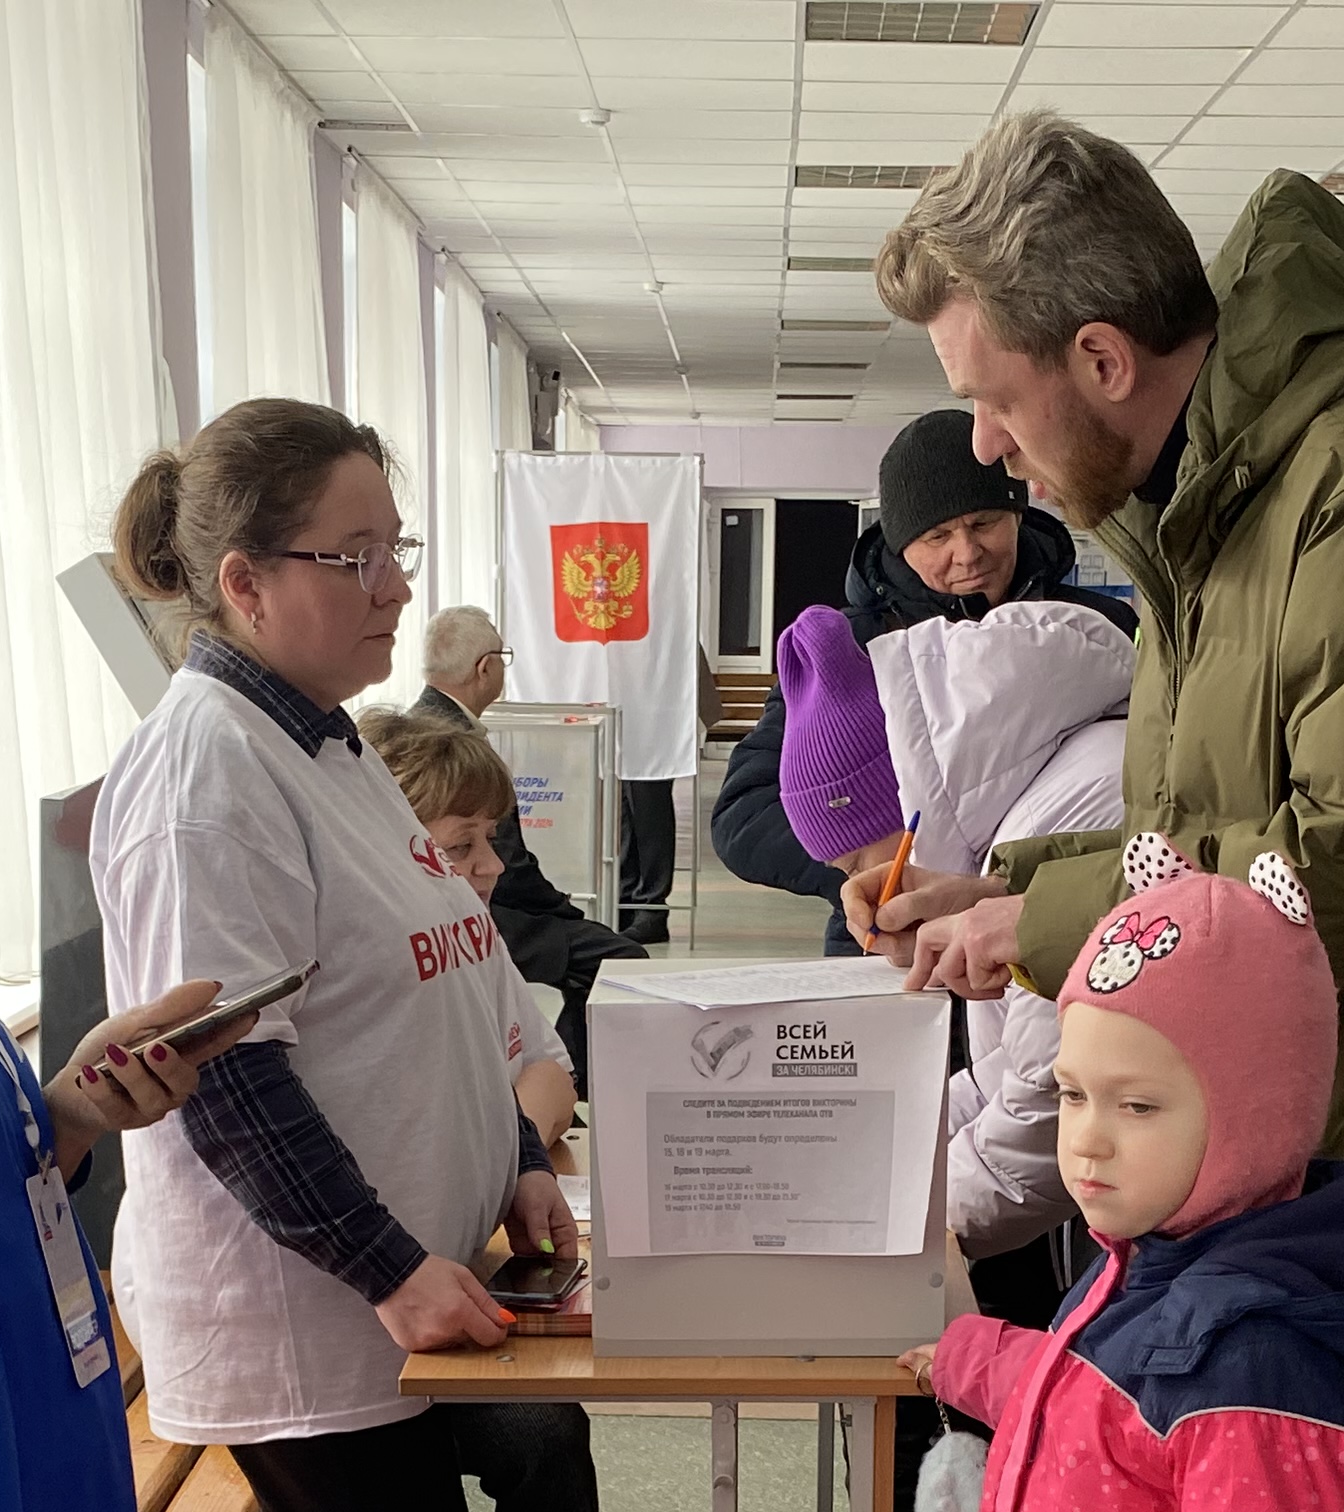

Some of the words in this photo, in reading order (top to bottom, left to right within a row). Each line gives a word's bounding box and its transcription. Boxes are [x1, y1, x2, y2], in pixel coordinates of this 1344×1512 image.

[776, 1020, 827, 1040] ВСЕЙ
[776, 1041, 855, 1060] СЕМЬЕЙ
[776, 1064, 790, 1076] ЗА
